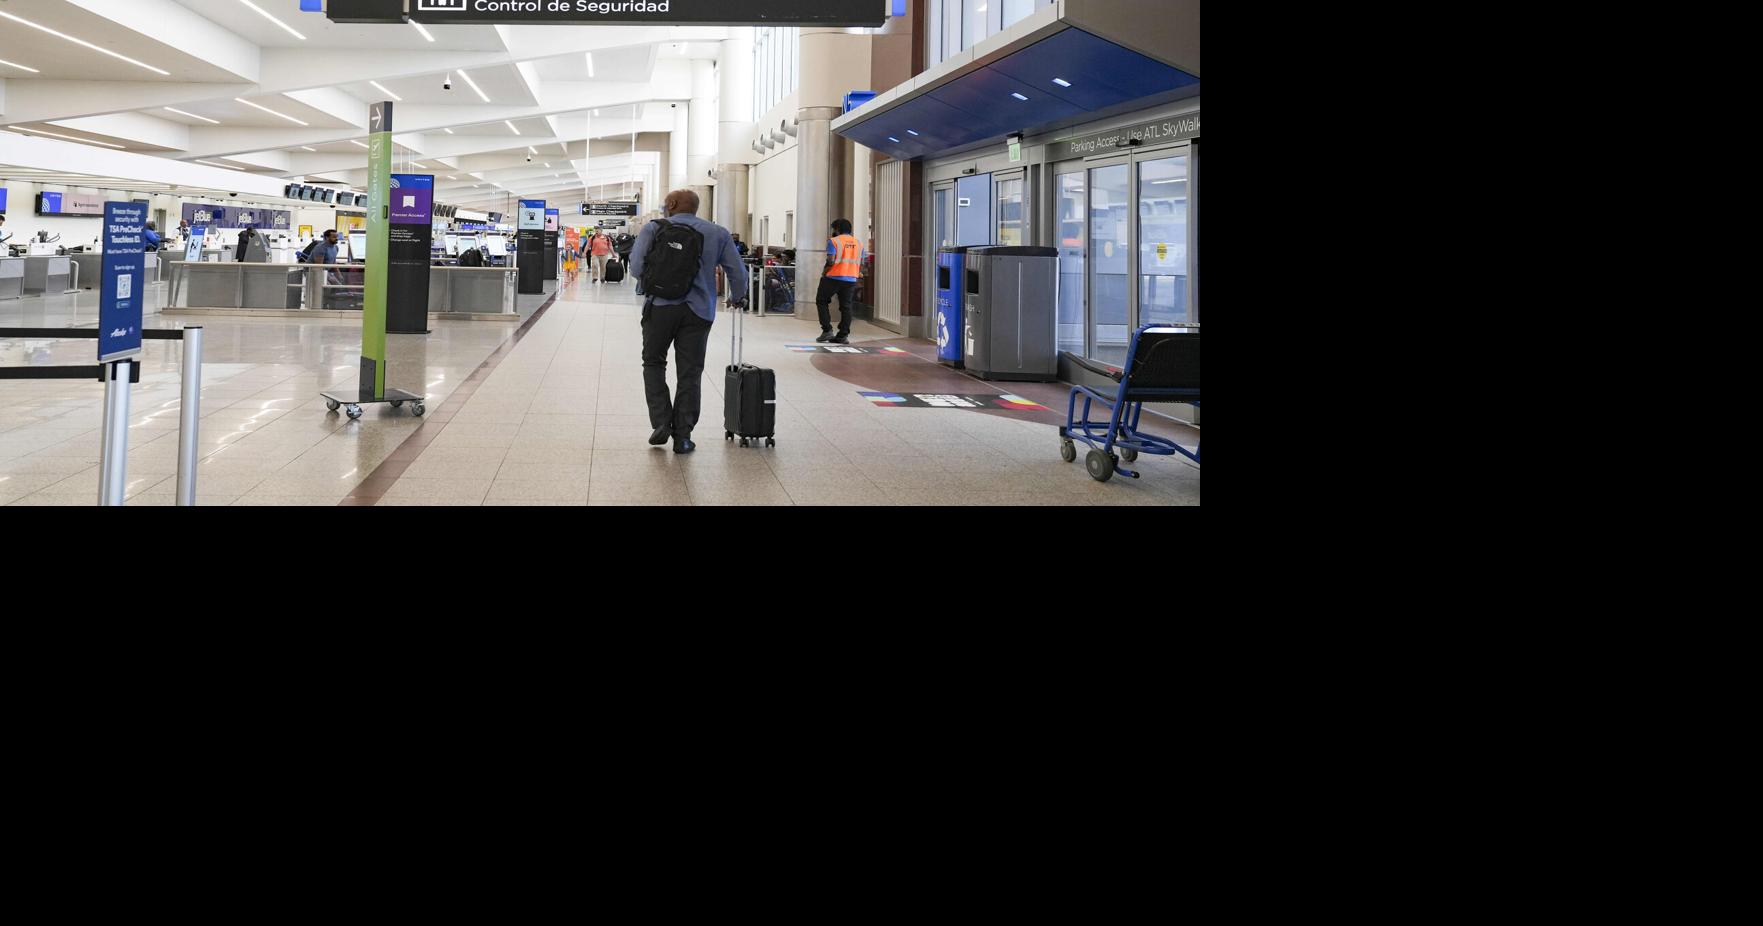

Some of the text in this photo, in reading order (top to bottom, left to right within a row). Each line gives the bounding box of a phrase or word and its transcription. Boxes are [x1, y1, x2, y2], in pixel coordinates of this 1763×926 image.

[474, 0, 670, 14] Control de Seguridad
[1070, 140, 1095, 153] Parking
[1144, 125, 1160, 139] ATL
[193, 209, 211, 224] jetBlue
[109, 225, 120, 233] TSA
